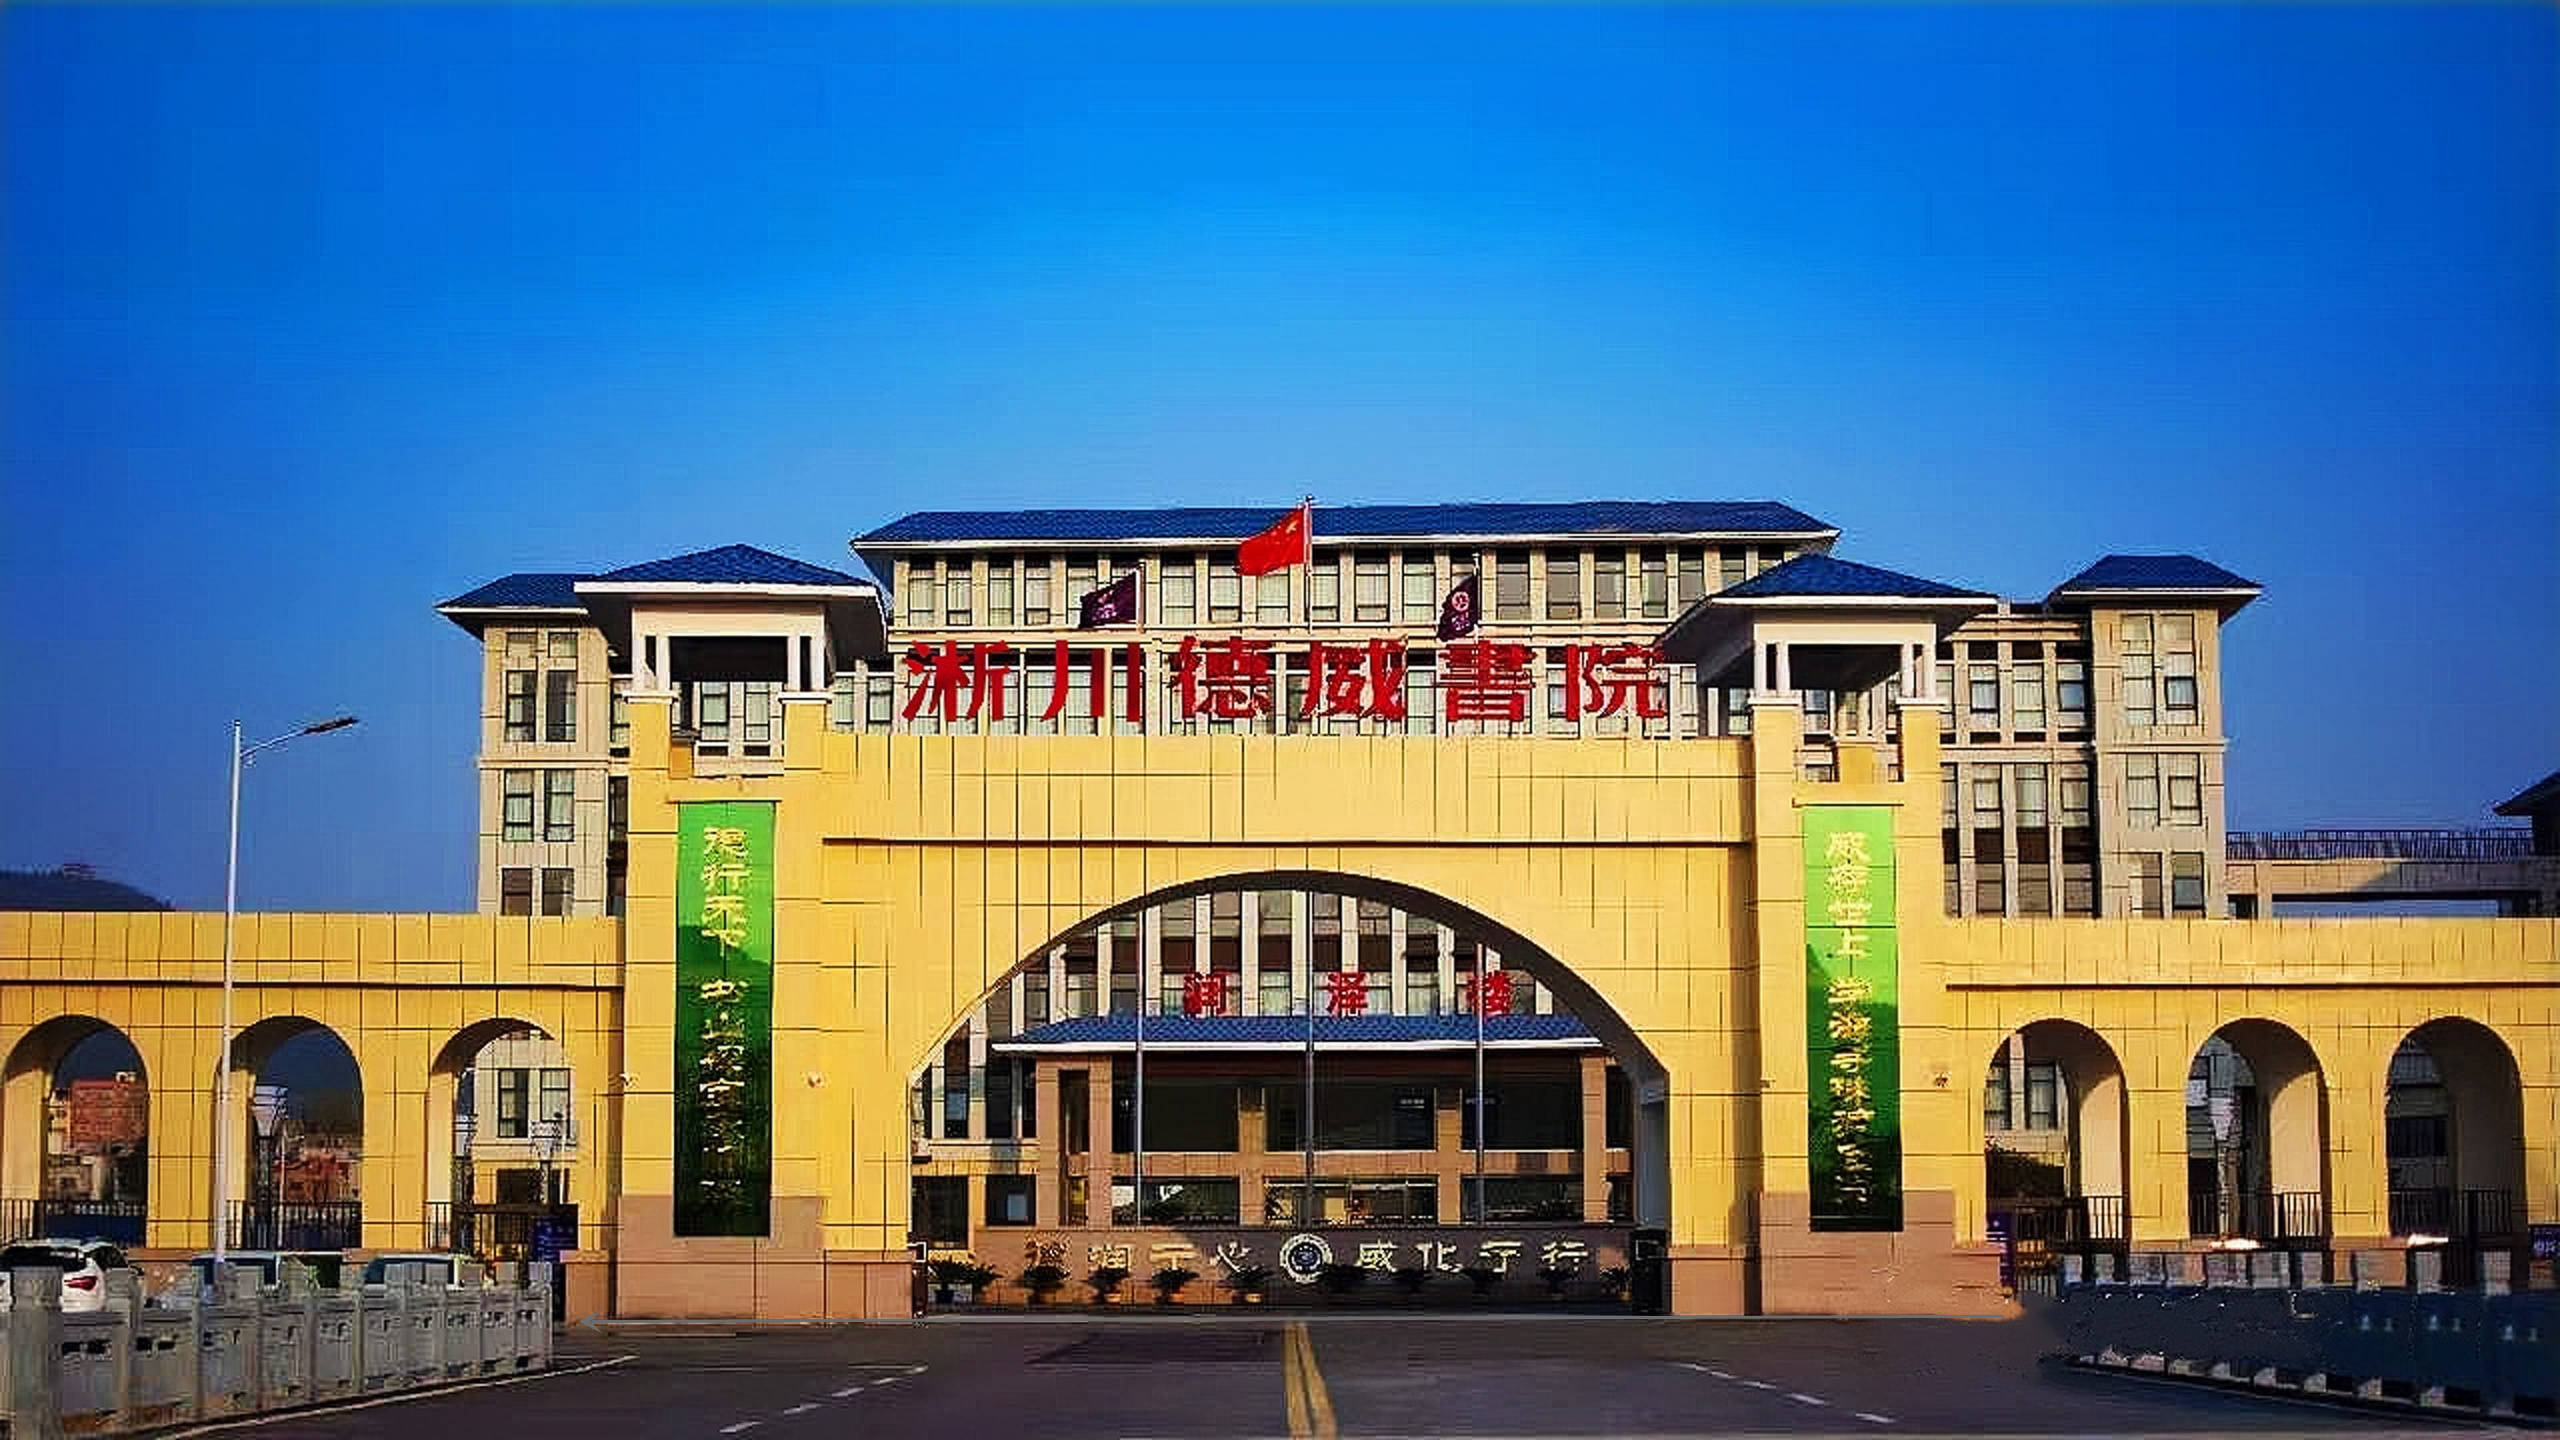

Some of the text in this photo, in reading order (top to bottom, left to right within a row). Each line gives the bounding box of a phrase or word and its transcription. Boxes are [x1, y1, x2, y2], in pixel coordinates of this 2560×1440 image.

[902, 635, 1666, 723] 淅川德威書院
